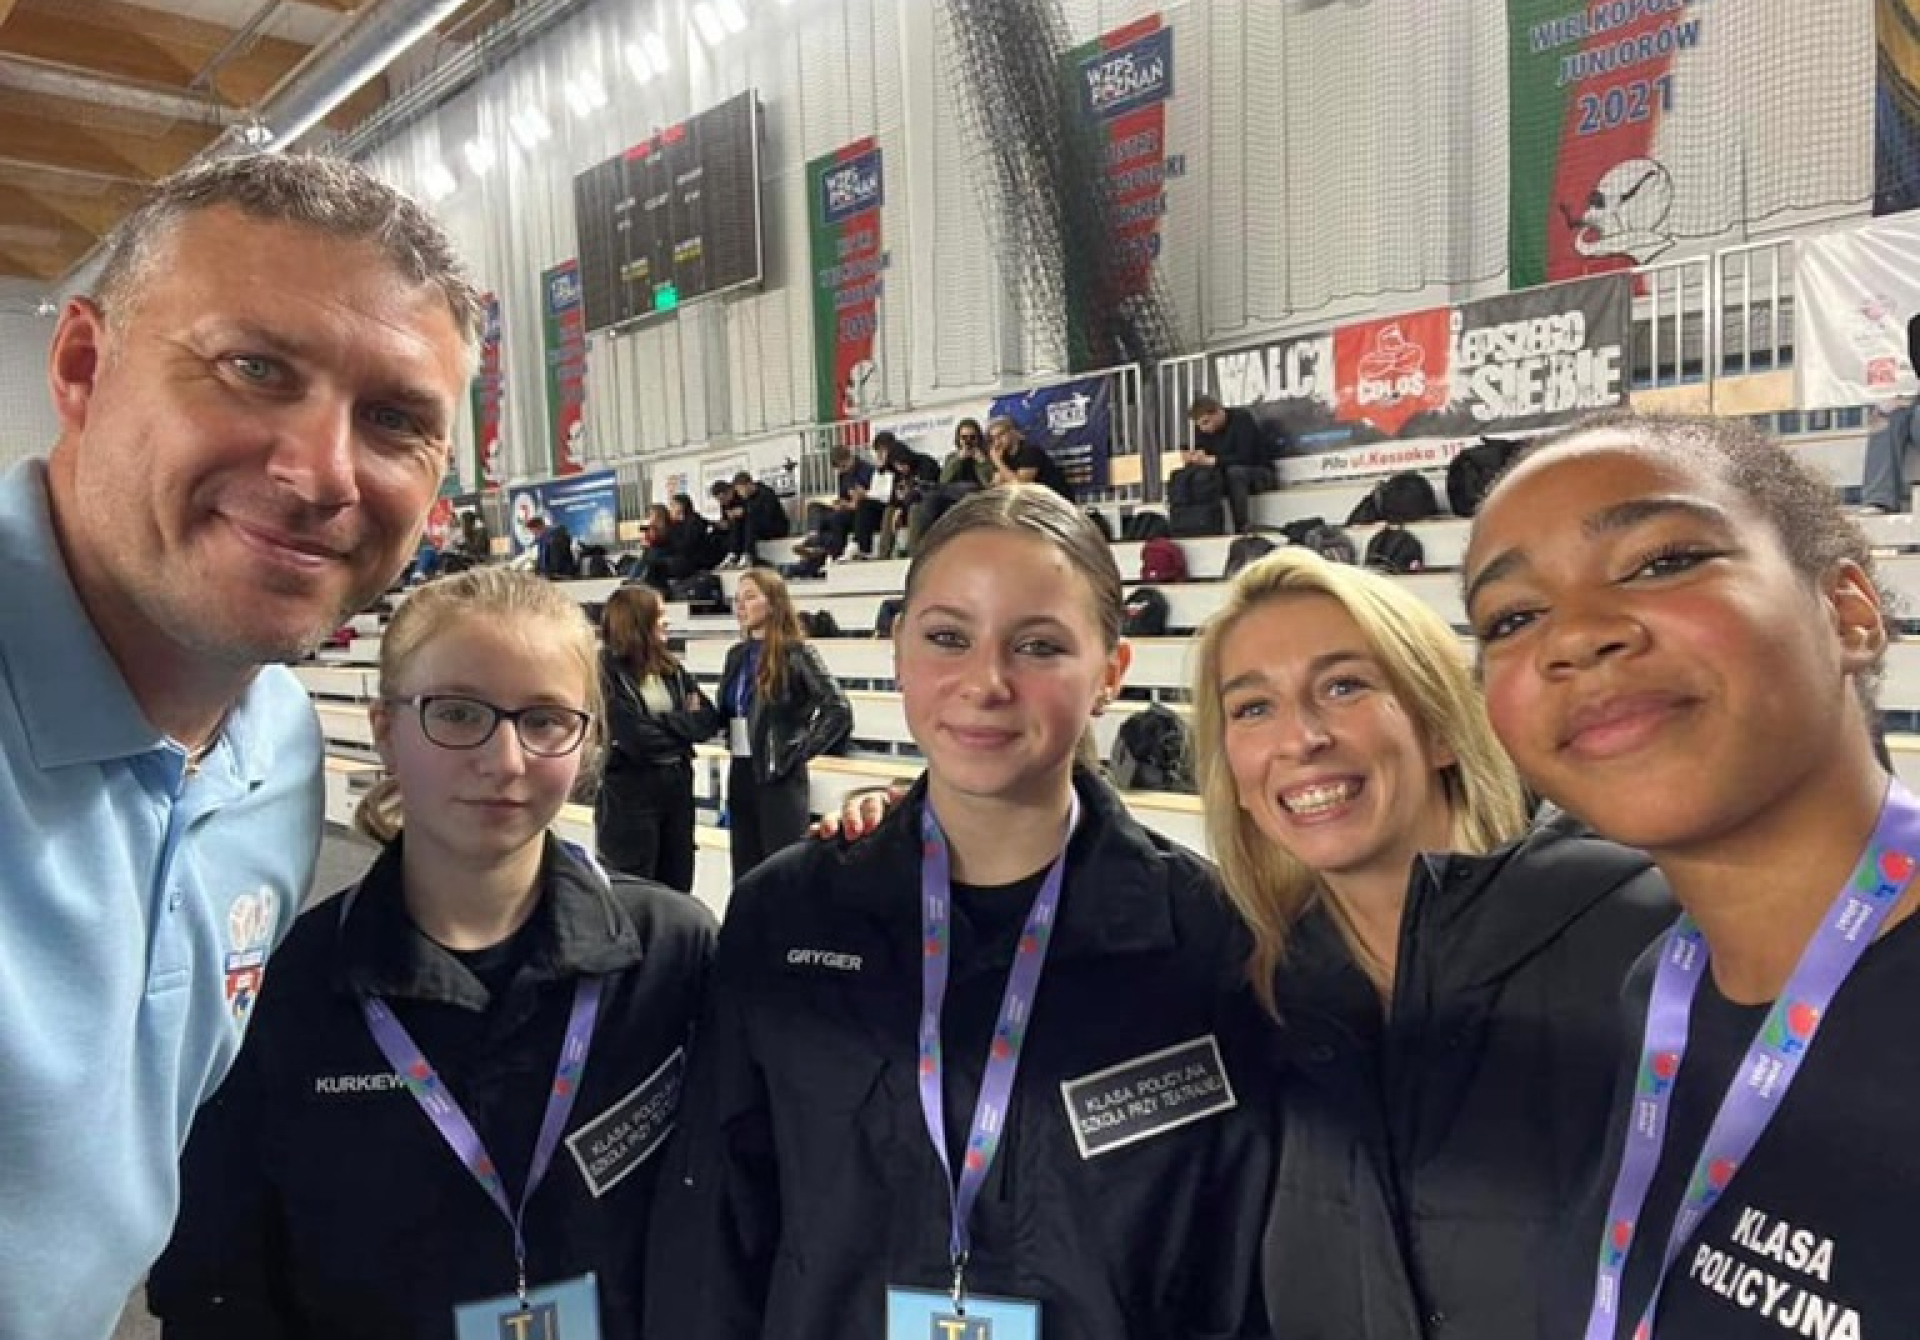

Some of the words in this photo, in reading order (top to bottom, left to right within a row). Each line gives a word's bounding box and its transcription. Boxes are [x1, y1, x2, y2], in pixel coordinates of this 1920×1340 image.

[1576, 74, 1676, 135] 2021
[787, 949, 863, 972] GRYGIER
[1731, 1206, 1836, 1282] KLASA
[1690, 1244, 1863, 1340] POLICYJNA
